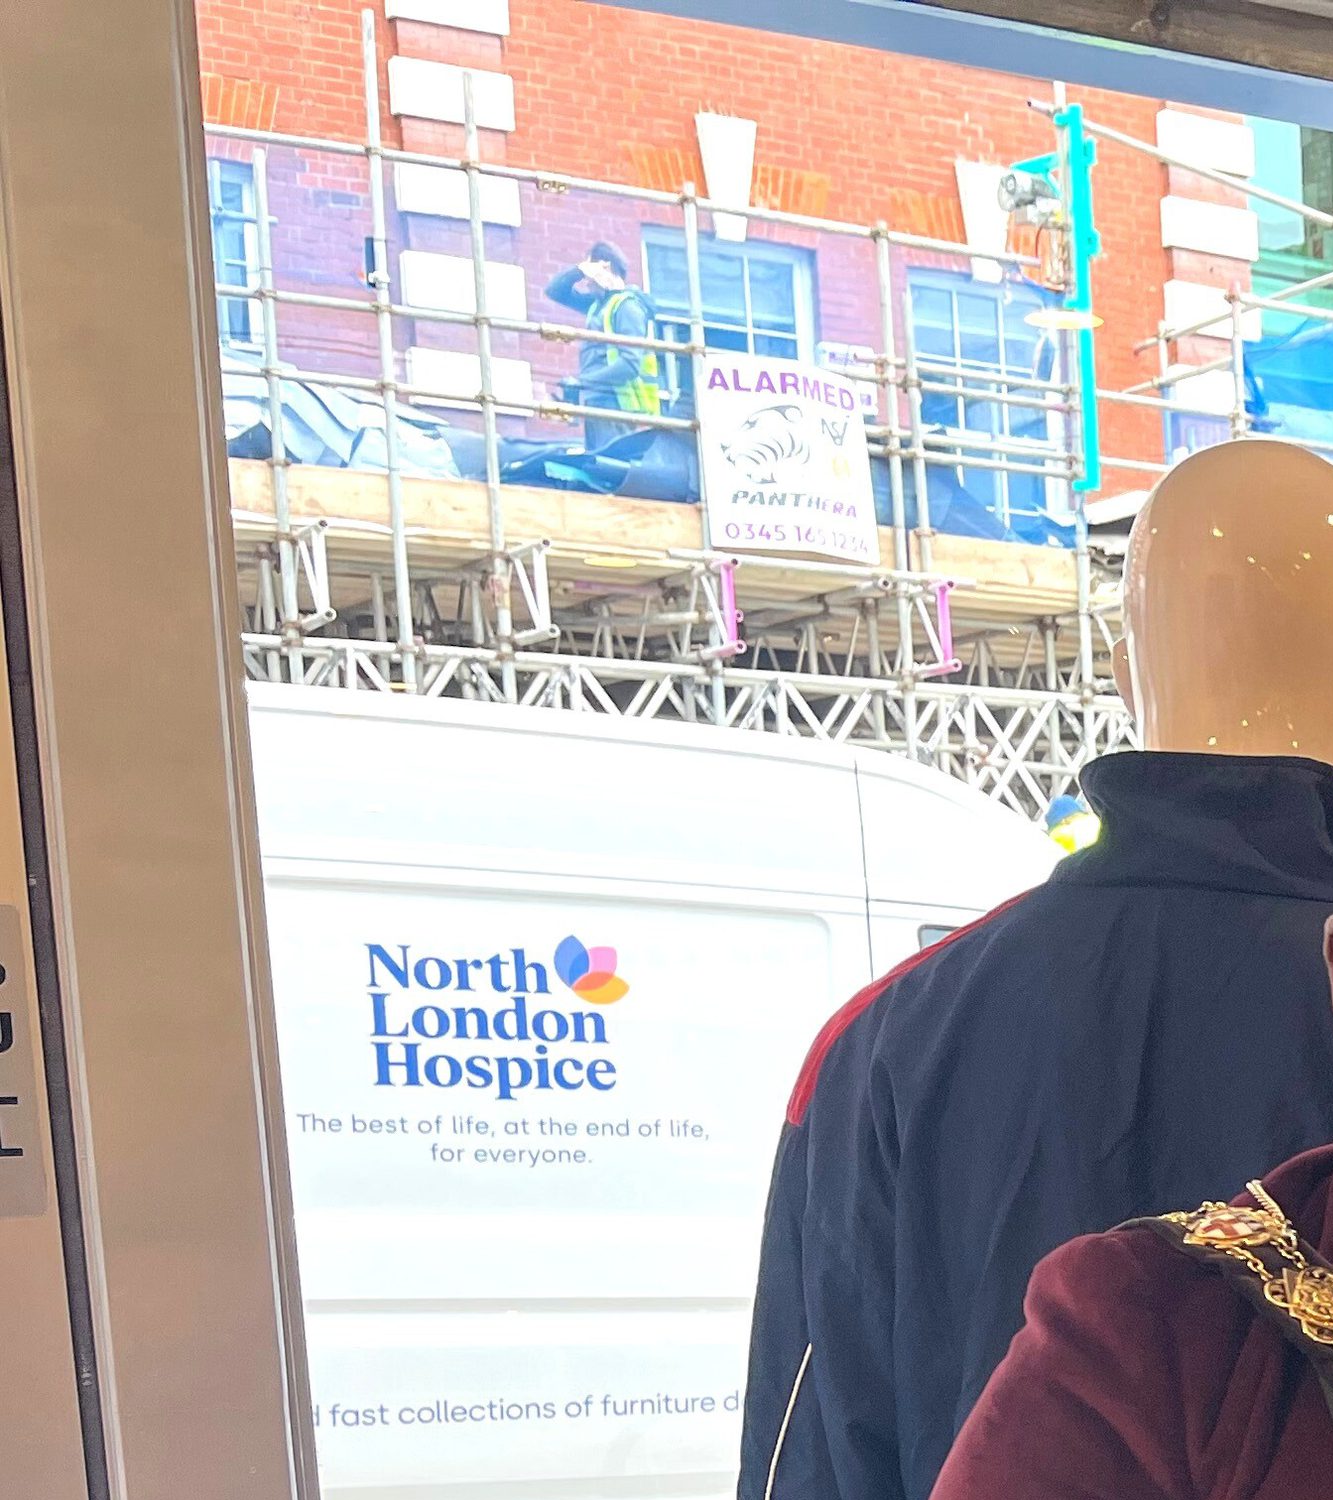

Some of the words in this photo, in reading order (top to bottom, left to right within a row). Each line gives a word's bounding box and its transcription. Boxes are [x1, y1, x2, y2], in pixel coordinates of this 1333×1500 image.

[707, 367, 855, 411] ALARMED
[730, 490, 857, 518] PANTHERA
[725, 521, 787, 542] 0345
[364, 943, 553, 994] North
[366, 992, 611, 1044] London
[369, 1041, 618, 1101] Hospice
[296, 1113, 343, 1135] The
[351, 1114, 409, 1135] best
[417, 1114, 442, 1135] of
[452, 1115, 496, 1138] life,
[504, 1118, 530, 1136] at
[539, 1116, 578, 1137] the
[586, 1118, 630, 1138] end
[638, 1118, 662, 1139] of
[670, 1119, 711, 1141] life,
[431, 1143, 466, 1164] for
[474, 1146, 593, 1169] everyone.
[329, 1403, 389, 1427] fast
[398, 1399, 557, 1427] collections
[565, 1395, 593, 1418] of
[602, 1393, 715, 1417] furniture
